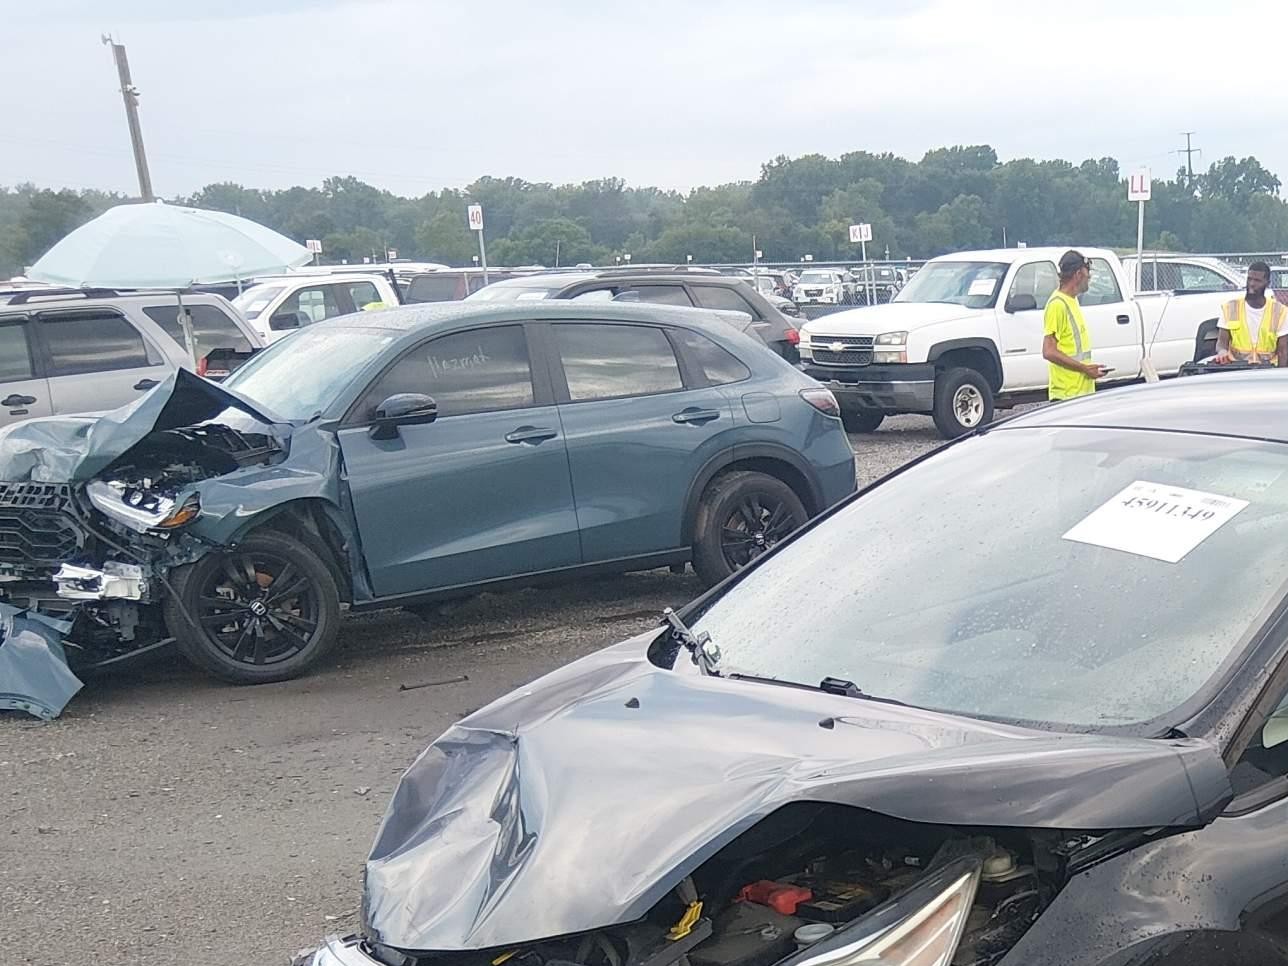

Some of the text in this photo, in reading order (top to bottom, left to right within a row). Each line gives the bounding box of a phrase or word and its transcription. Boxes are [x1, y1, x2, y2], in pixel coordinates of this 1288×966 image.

[1130, 175, 1149, 193] LL
[470, 211, 481, 225] 40
[1121, 497, 1216, 520] 45911349
